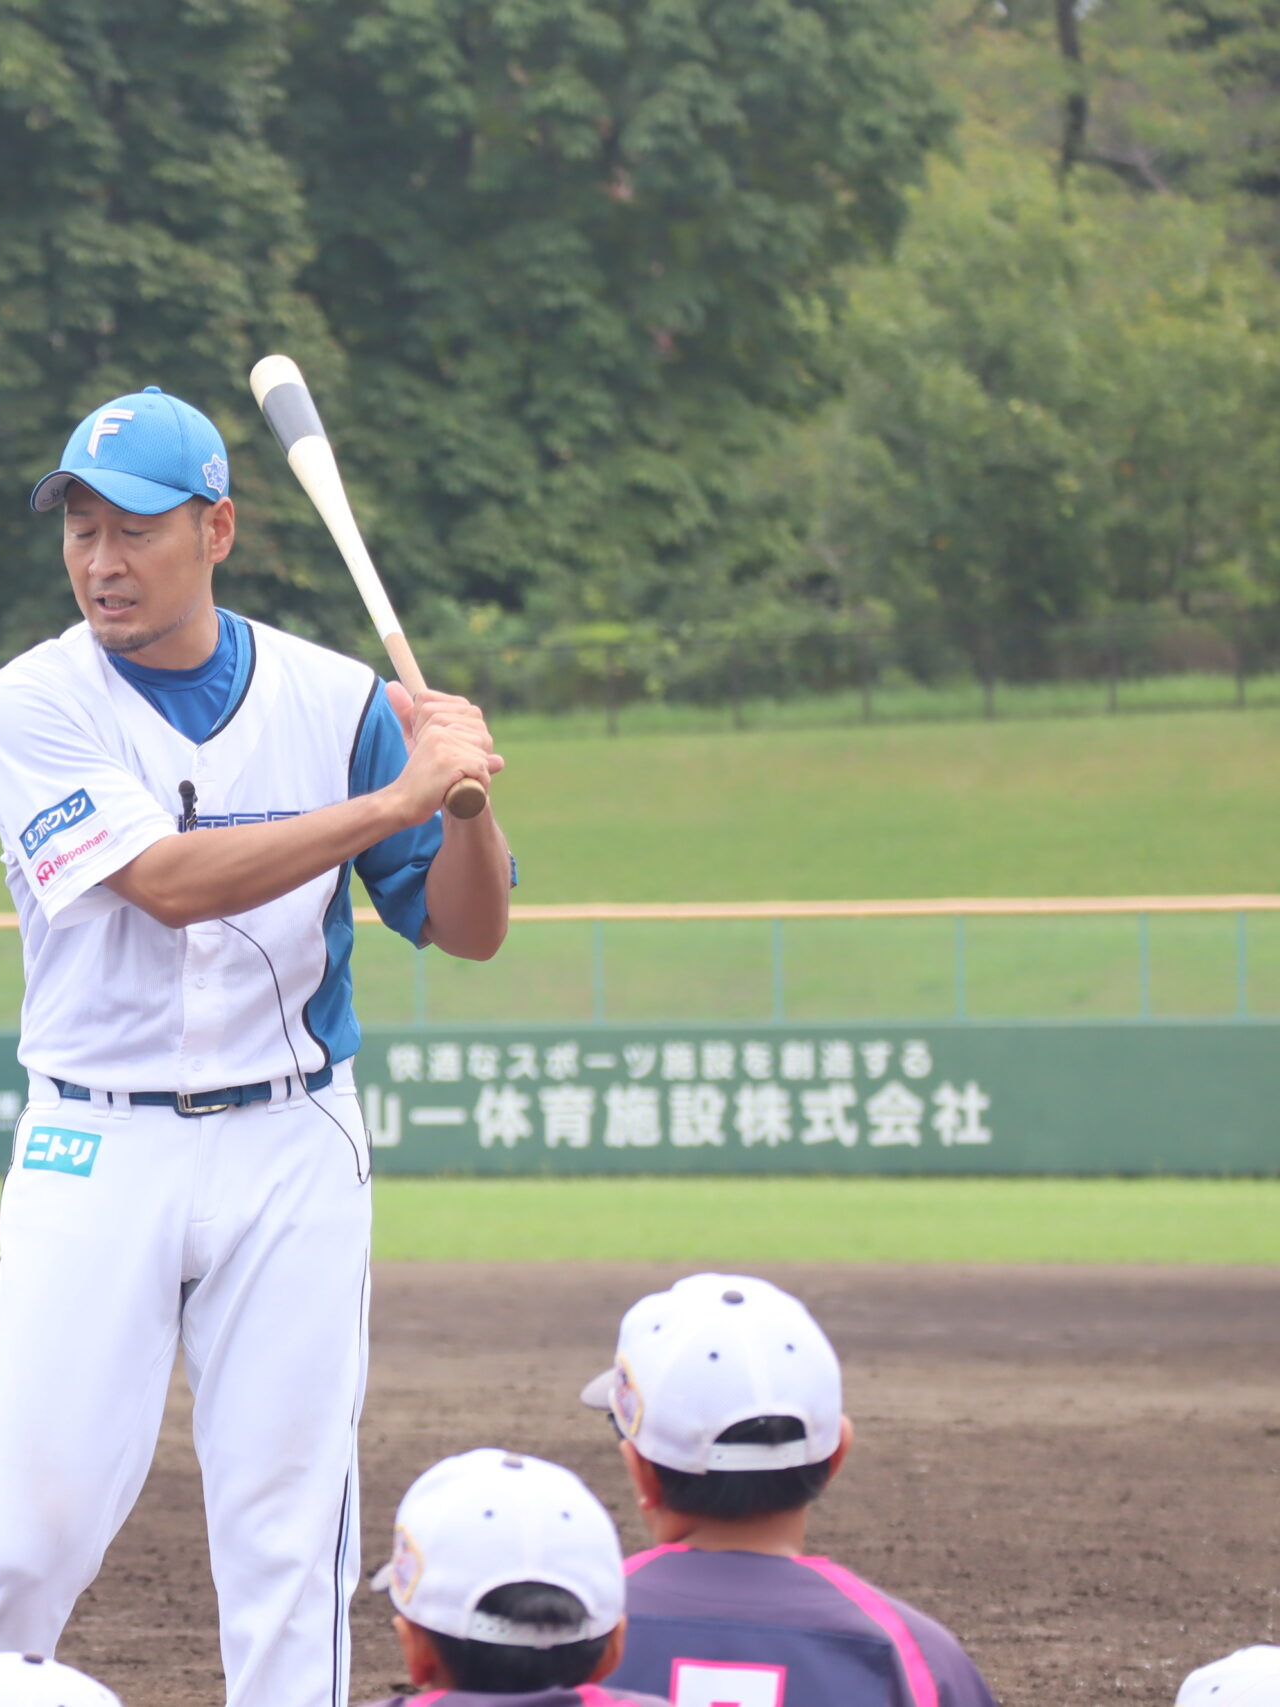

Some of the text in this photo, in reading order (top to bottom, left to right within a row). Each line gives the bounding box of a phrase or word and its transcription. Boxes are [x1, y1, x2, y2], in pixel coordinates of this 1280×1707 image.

[87, 408, 135, 459] F
[34, 797, 86, 839] ホクレン
[364, 1080, 992, 1149] 山一体育施設株式会社
[27, 1133, 95, 1167] ニトリ
